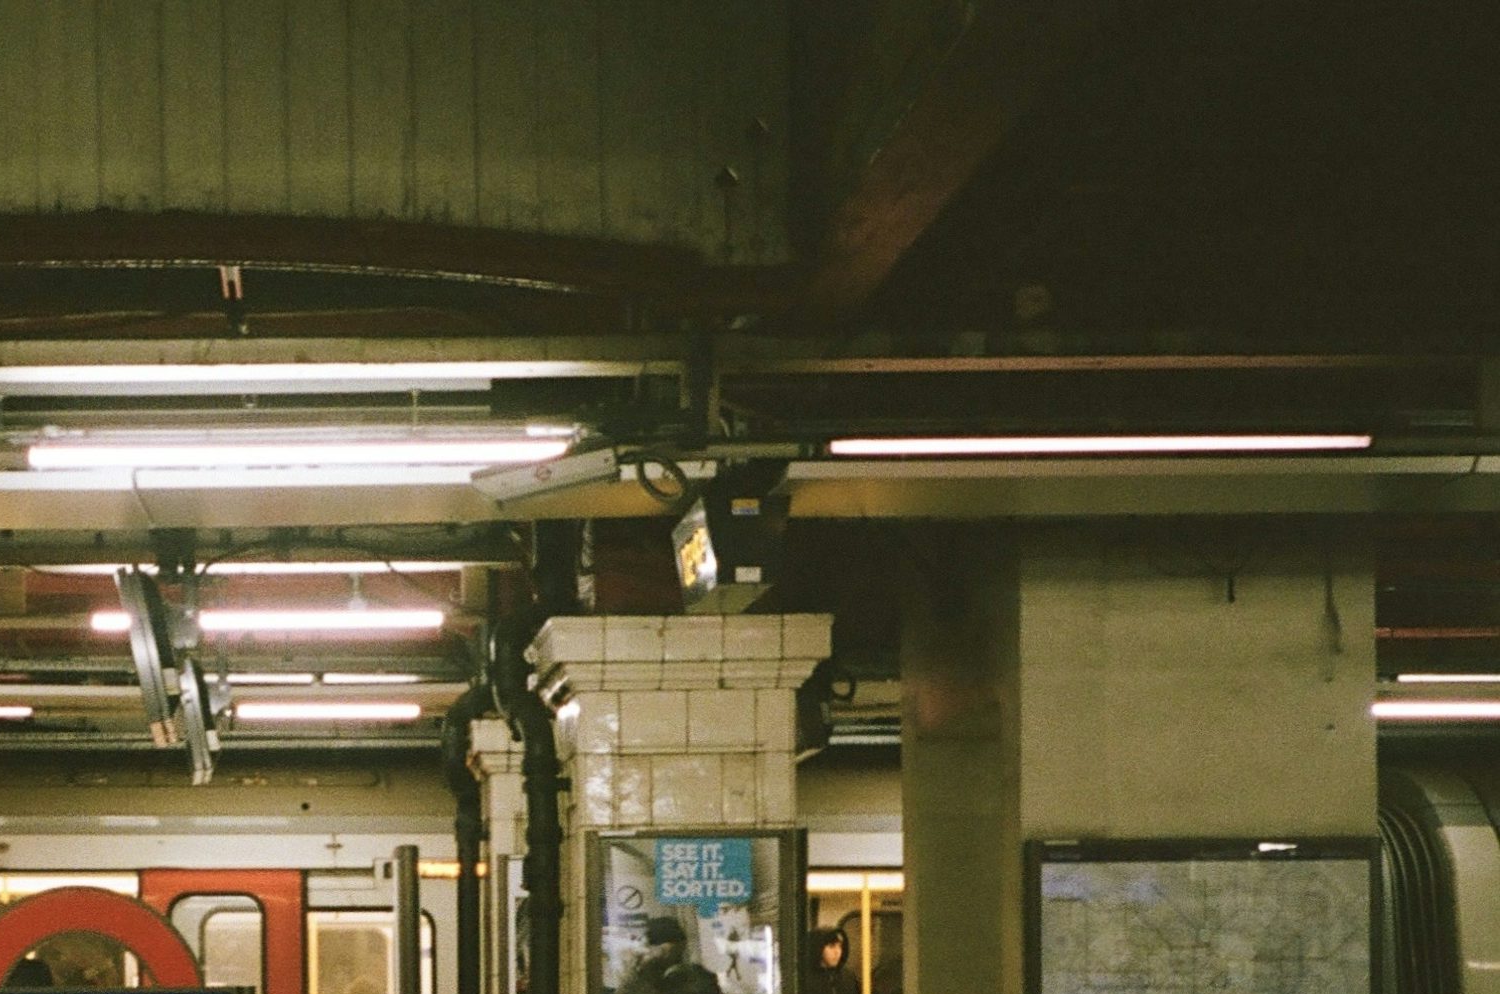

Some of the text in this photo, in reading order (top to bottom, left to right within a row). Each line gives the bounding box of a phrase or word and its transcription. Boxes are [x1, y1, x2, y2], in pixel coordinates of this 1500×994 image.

[662, 844, 698, 861] SEE
[662, 862, 699, 879] SAY
[662, 880, 750, 897] SORTED.
